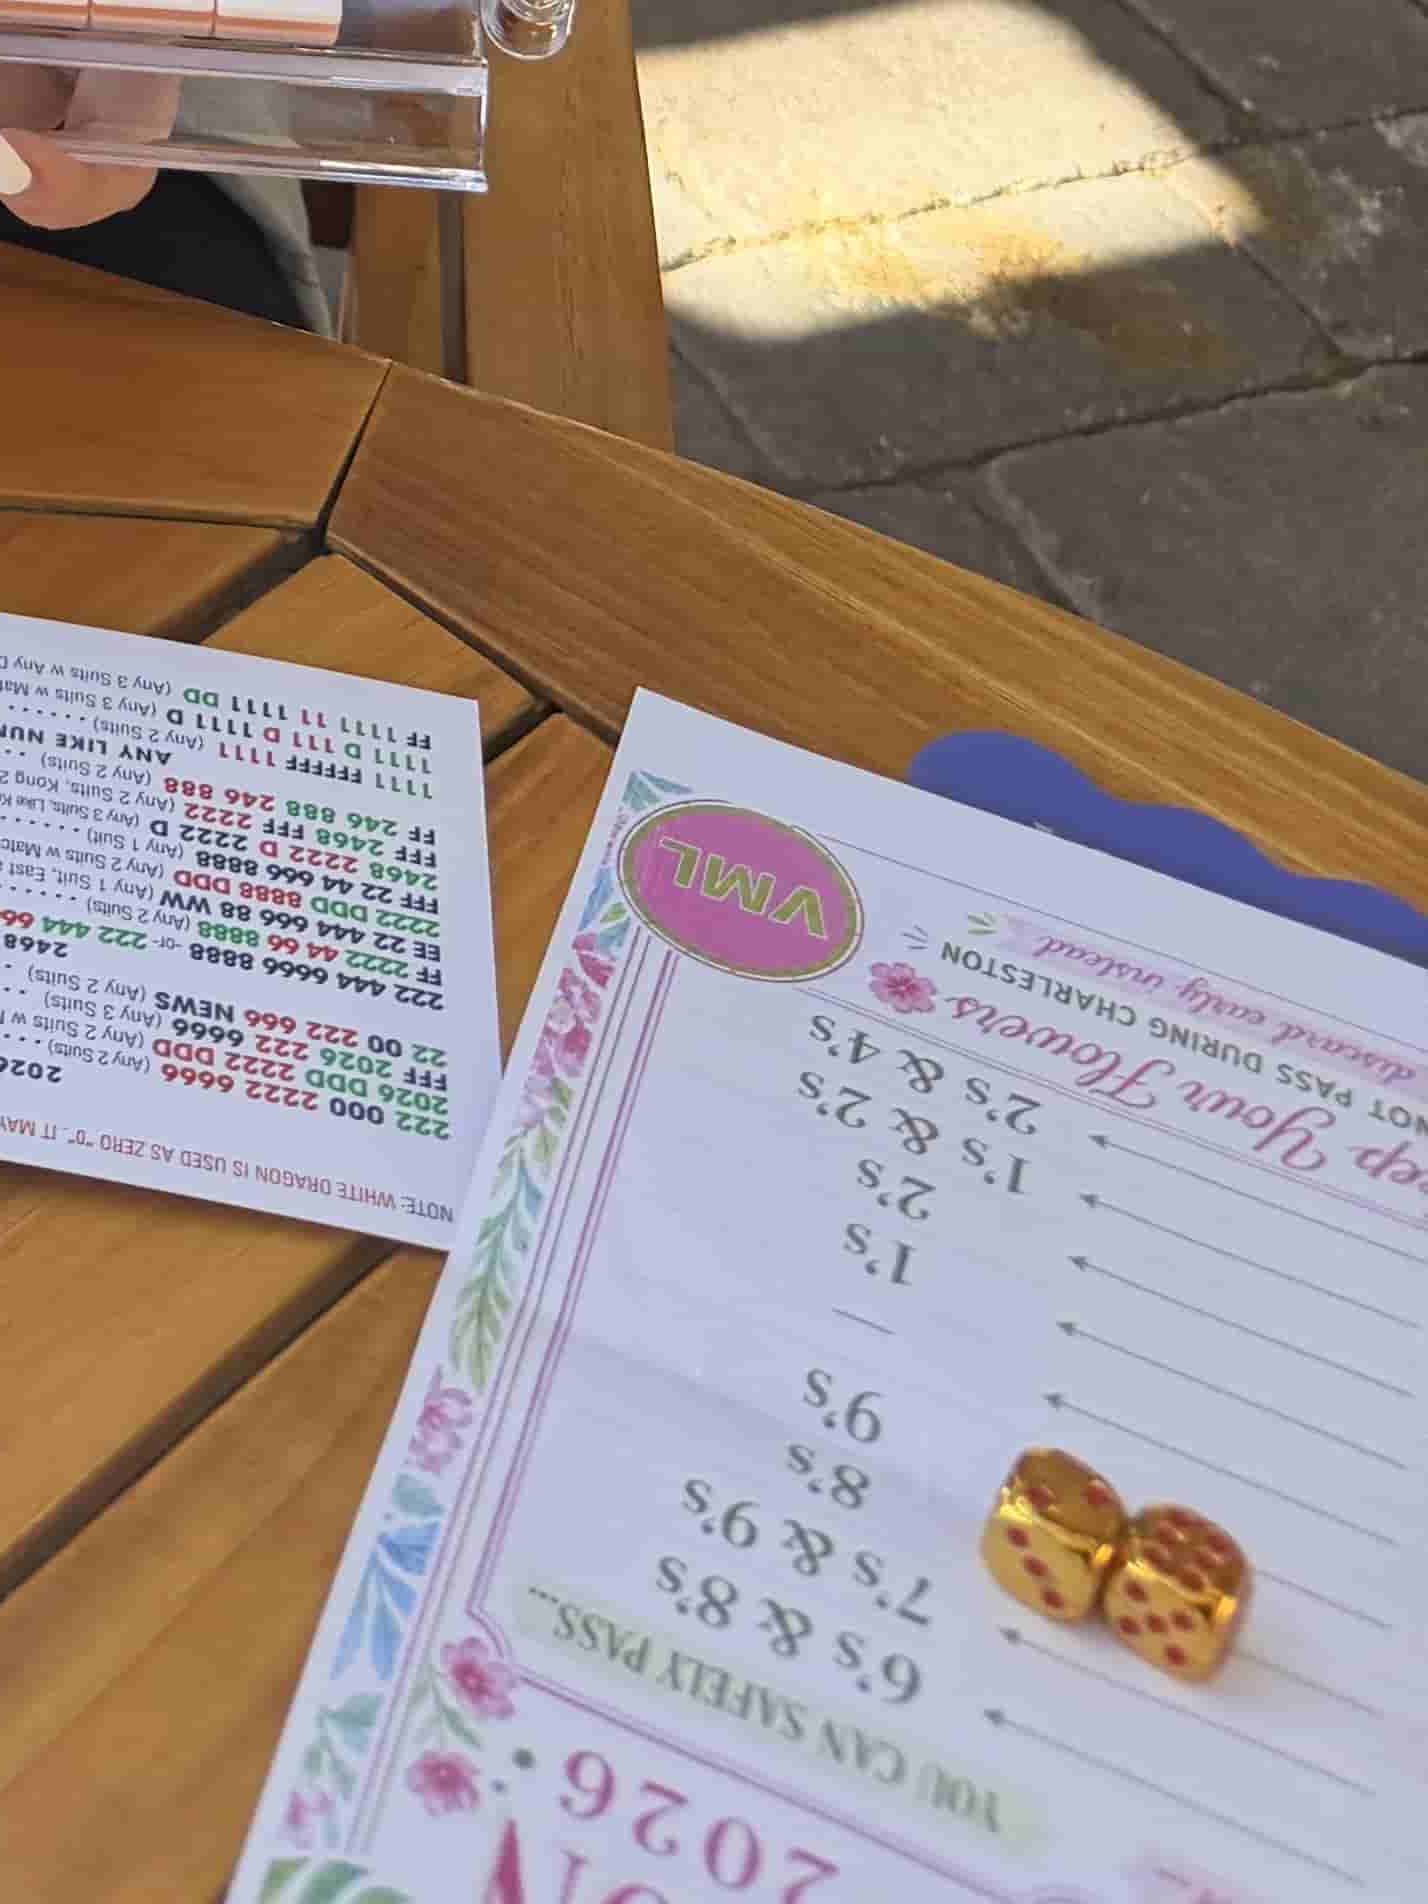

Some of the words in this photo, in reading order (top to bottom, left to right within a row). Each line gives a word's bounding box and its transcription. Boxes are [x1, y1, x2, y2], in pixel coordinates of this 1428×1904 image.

[55, 732, 107, 756] LIKE
[118, 743, 172, 766] ANY
[172, 869, 231, 895] DDD
[238, 881, 302, 908] 8888
[658, 833, 825, 941] VML
[159, 889, 212, 915] WW
[219, 901, 252, 922] 88
[309, 896, 368, 923] DDD
[41, 916, 91, 939] 444
[197, 920, 260, 947] 8888
[259, 909, 309, 933] 666
[316, 920, 366, 944] 444
[375, 909, 440, 938] 2222
[3, 933, 68, 958] 2468
[97, 925, 147, 950] 222
[267, 934, 300, 955] 66
[306, 941, 339, 962] 44
[372, 931, 406, 954] 22
[412, 940, 441, 962] EE
[189, 943, 254, 970] 8888
[261, 957, 328, 985] 6666
[344, 949, 409, 979] 2222
[1031, 935, 1165, 994] instead
[335, 971, 387, 997] 444
[415, 966, 442, 986] FF
[940, 941, 1137, 1027] CHARLESTON
[154, 991, 234, 1023] NEWS
[393, 983, 444, 1011] 222
[1175, 976, 1268, 1026] early
[171, 1018, 244, 1047] 6666
[243, 1009, 296, 1034] 666
[306, 1021, 358, 1047] 222
[151, 1038, 214, 1066] DDD
[255, 1034, 309, 1061] 222
[367, 1034, 402, 1057] 00
[808, 1015, 881, 1064] 4's
[943, 996, 1176, 1110] Flowers
[1147, 1016, 1264, 1075] DURING
[224, 1051, 295, 1081] 2222
[319, 1047, 392, 1078] 2026
[411, 1043, 448, 1068] 22
[1269, 1021, 1421, 1091] discard
[161, 1063, 234, 1093] 6666
[304, 1069, 368, 1097] DDD
[403, 1066, 448, 1092] FFF
[895, 1049, 945, 1094] &
[1275, 1063, 1353, 1109] PASS
[245, 1079, 318, 1111] 2222
[377, 1083, 448, 1115] 2026
[797, 1071, 873, 1129] 2's
[964, 1077, 1043, 1135] 2's
[329, 1097, 384, 1125] 000
[394, 1110, 450, 1140] 222
[1175, 1080, 1336, 1171] Your
[40, 1123, 57, 1140] IT
[99, 1133, 145, 1158] ZERO
[887, 1107, 940, 1156] &
[151, 1143, 175, 1163] AS
[180, 1150, 226, 1173] USED
[961, 1137, 1031, 1195] 1's
[232, 1160, 248, 1177] IS
[255, 1164, 332, 1195] DRAGON
[335, 1181, 397, 1210] WHITE
[856, 1158, 937, 1221] 2's
[400, 1196, 454, 1223] NOTE:
[842, 1223, 916, 1286] 1's
[802, 1367, 882, 1444] 9's
[786, 1443, 872, 1510] 8's
[681, 1479, 760, 1549] 9's
[781, 1519, 835, 1577] &
[655, 1556, 740, 1629] 8's
[852, 1551, 933, 1628] 7's
[516, 1584, 652, 1676] PASS...
[756, 1597, 813, 1659] &
[832, 1631, 922, 1705] 6's
[655, 1648, 808, 1743] SAFELY
[816, 1719, 908, 1788] CAN
[558, 1748, 842, 1904] 2026
